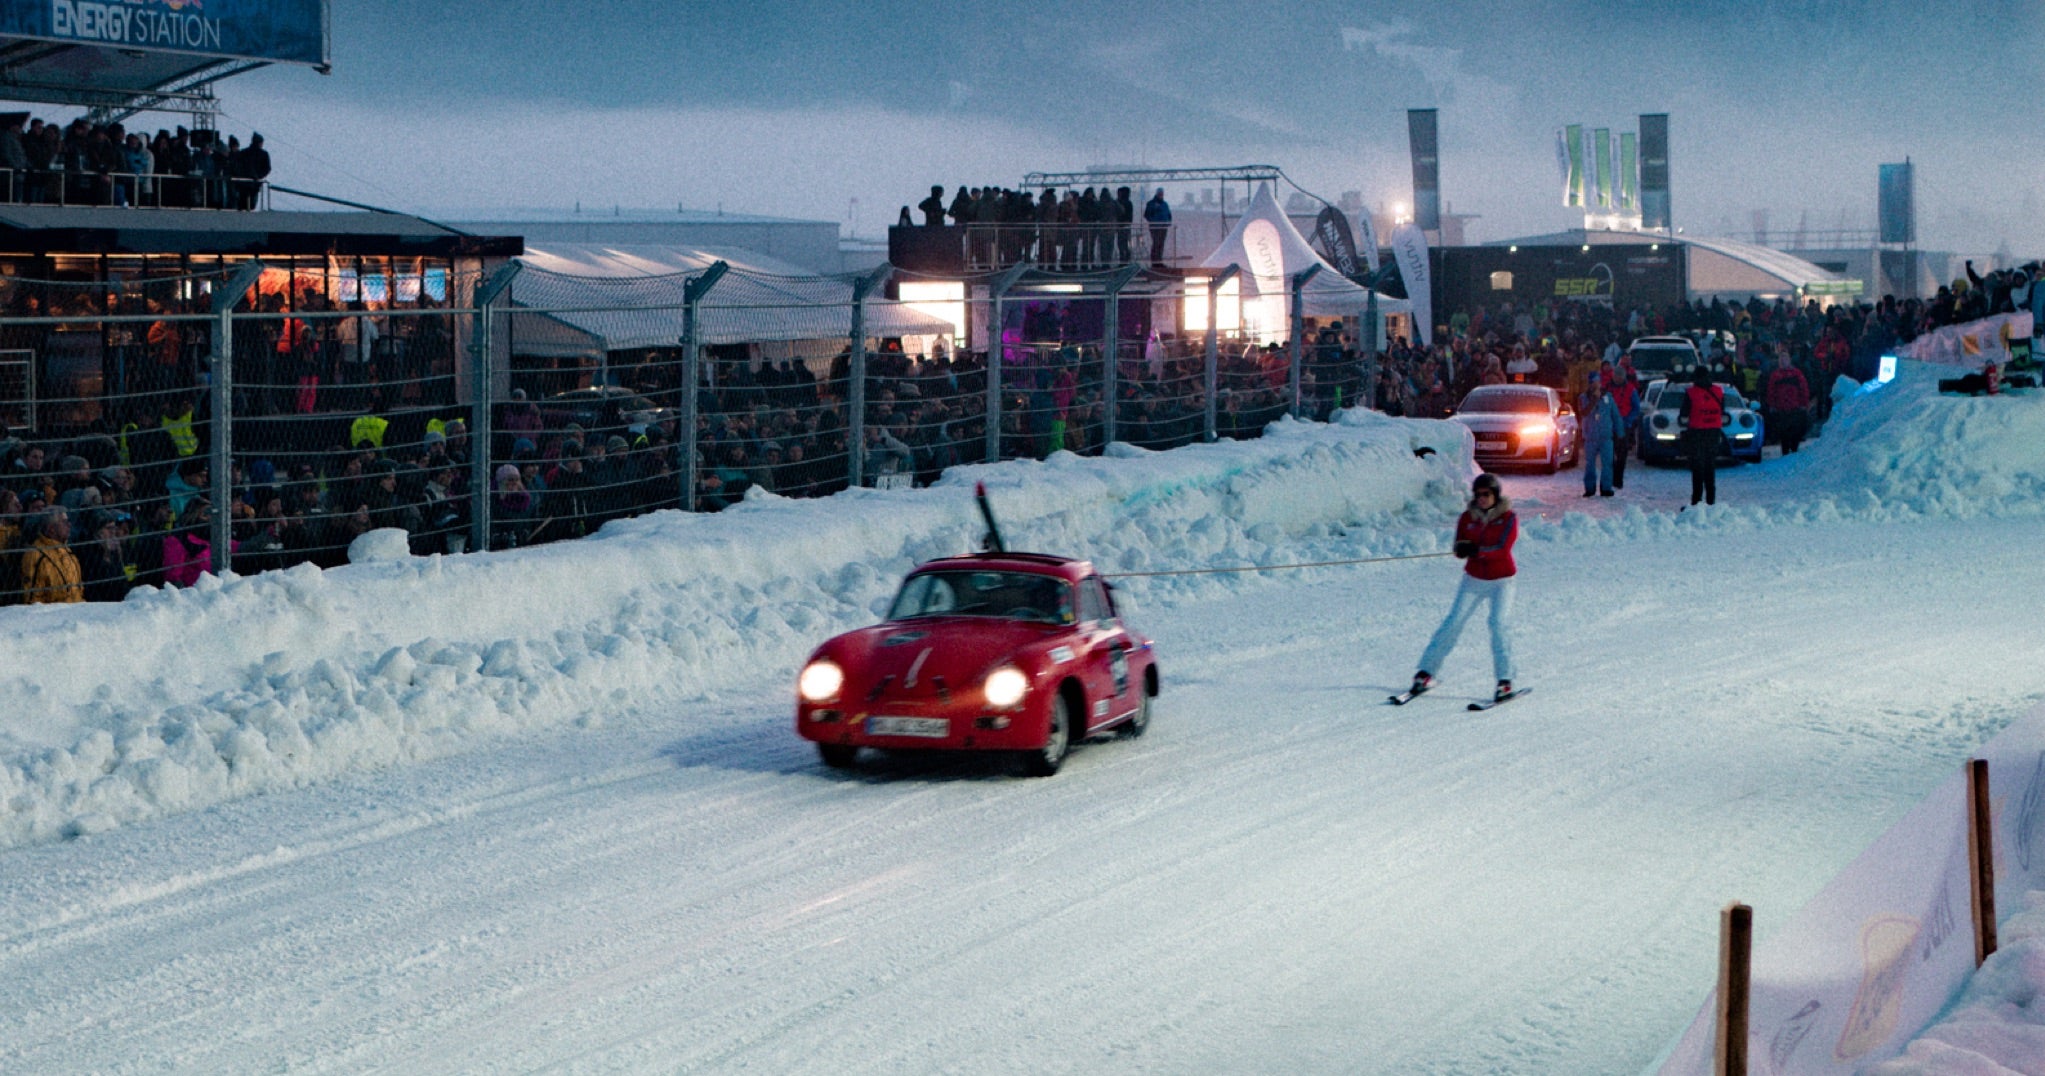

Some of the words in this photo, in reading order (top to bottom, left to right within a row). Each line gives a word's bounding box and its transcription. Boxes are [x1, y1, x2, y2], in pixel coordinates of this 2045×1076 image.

[53, 0, 132, 41] ENERGY
[135, 9, 220, 48] STATION
[1554, 277, 1598, 295] SSR
